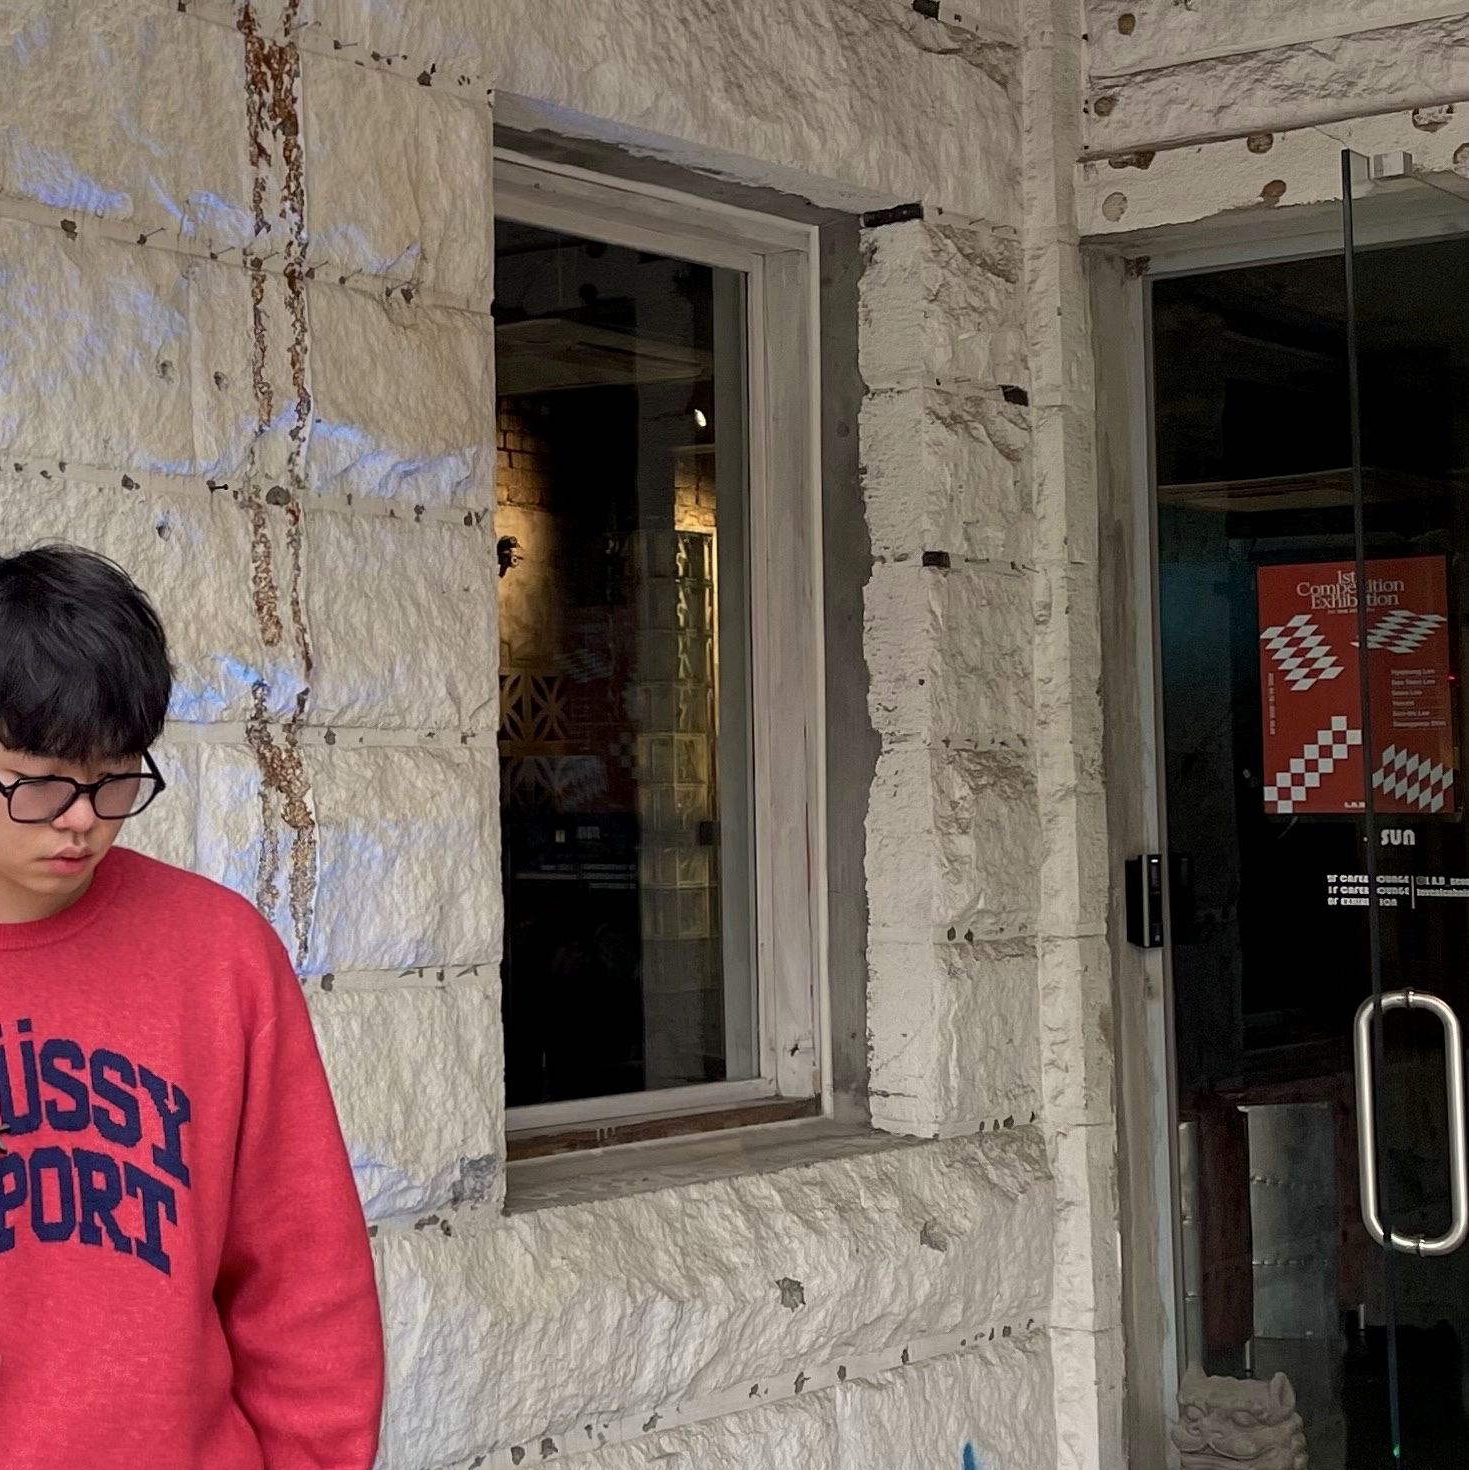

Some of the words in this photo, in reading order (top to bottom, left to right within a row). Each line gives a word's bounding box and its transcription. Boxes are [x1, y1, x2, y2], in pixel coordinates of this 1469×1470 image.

[1296, 578, 1405, 599] Compeition
[1311, 593, 1400, 610] Exhibtion
[1380, 829, 1416, 846] SUN
